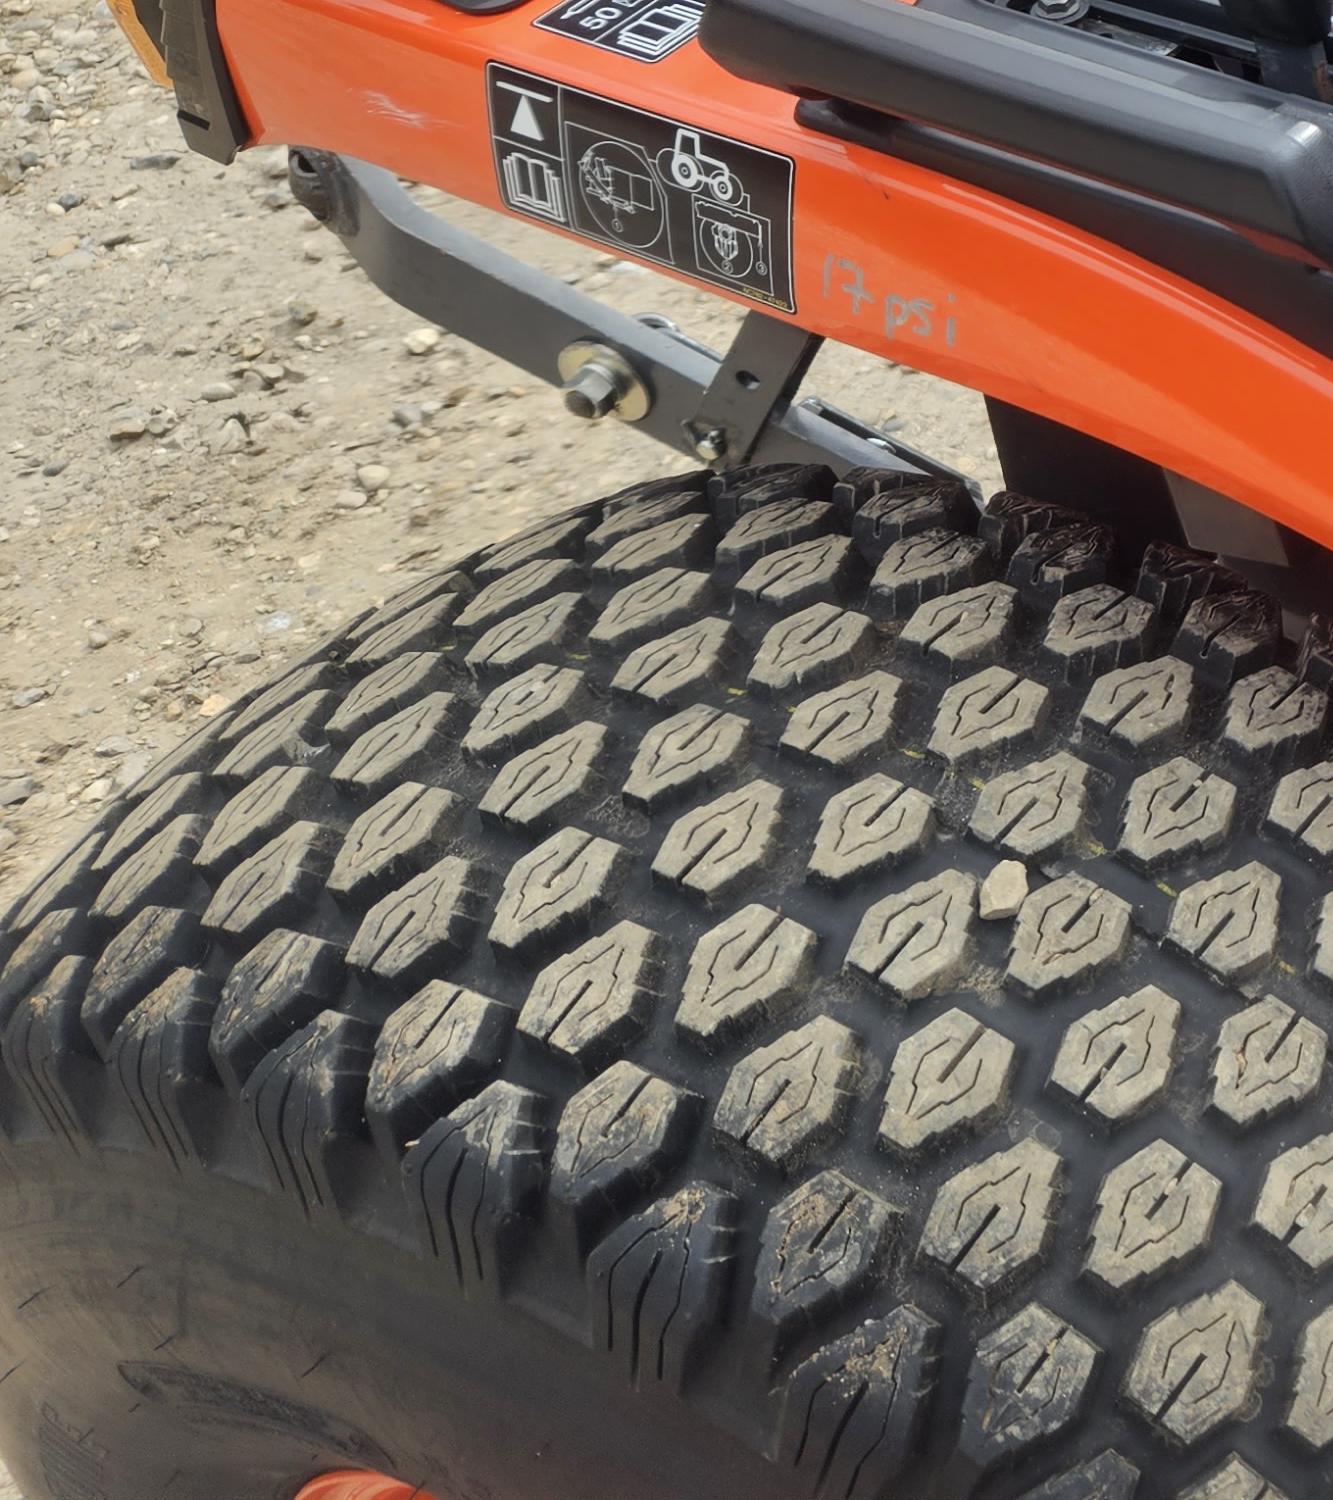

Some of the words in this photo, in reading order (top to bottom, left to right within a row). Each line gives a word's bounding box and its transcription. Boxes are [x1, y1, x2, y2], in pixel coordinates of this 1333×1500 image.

[579, 7, 622, 30] 50
[823, 253, 875, 315] 17
[885, 294, 956, 347] psi
